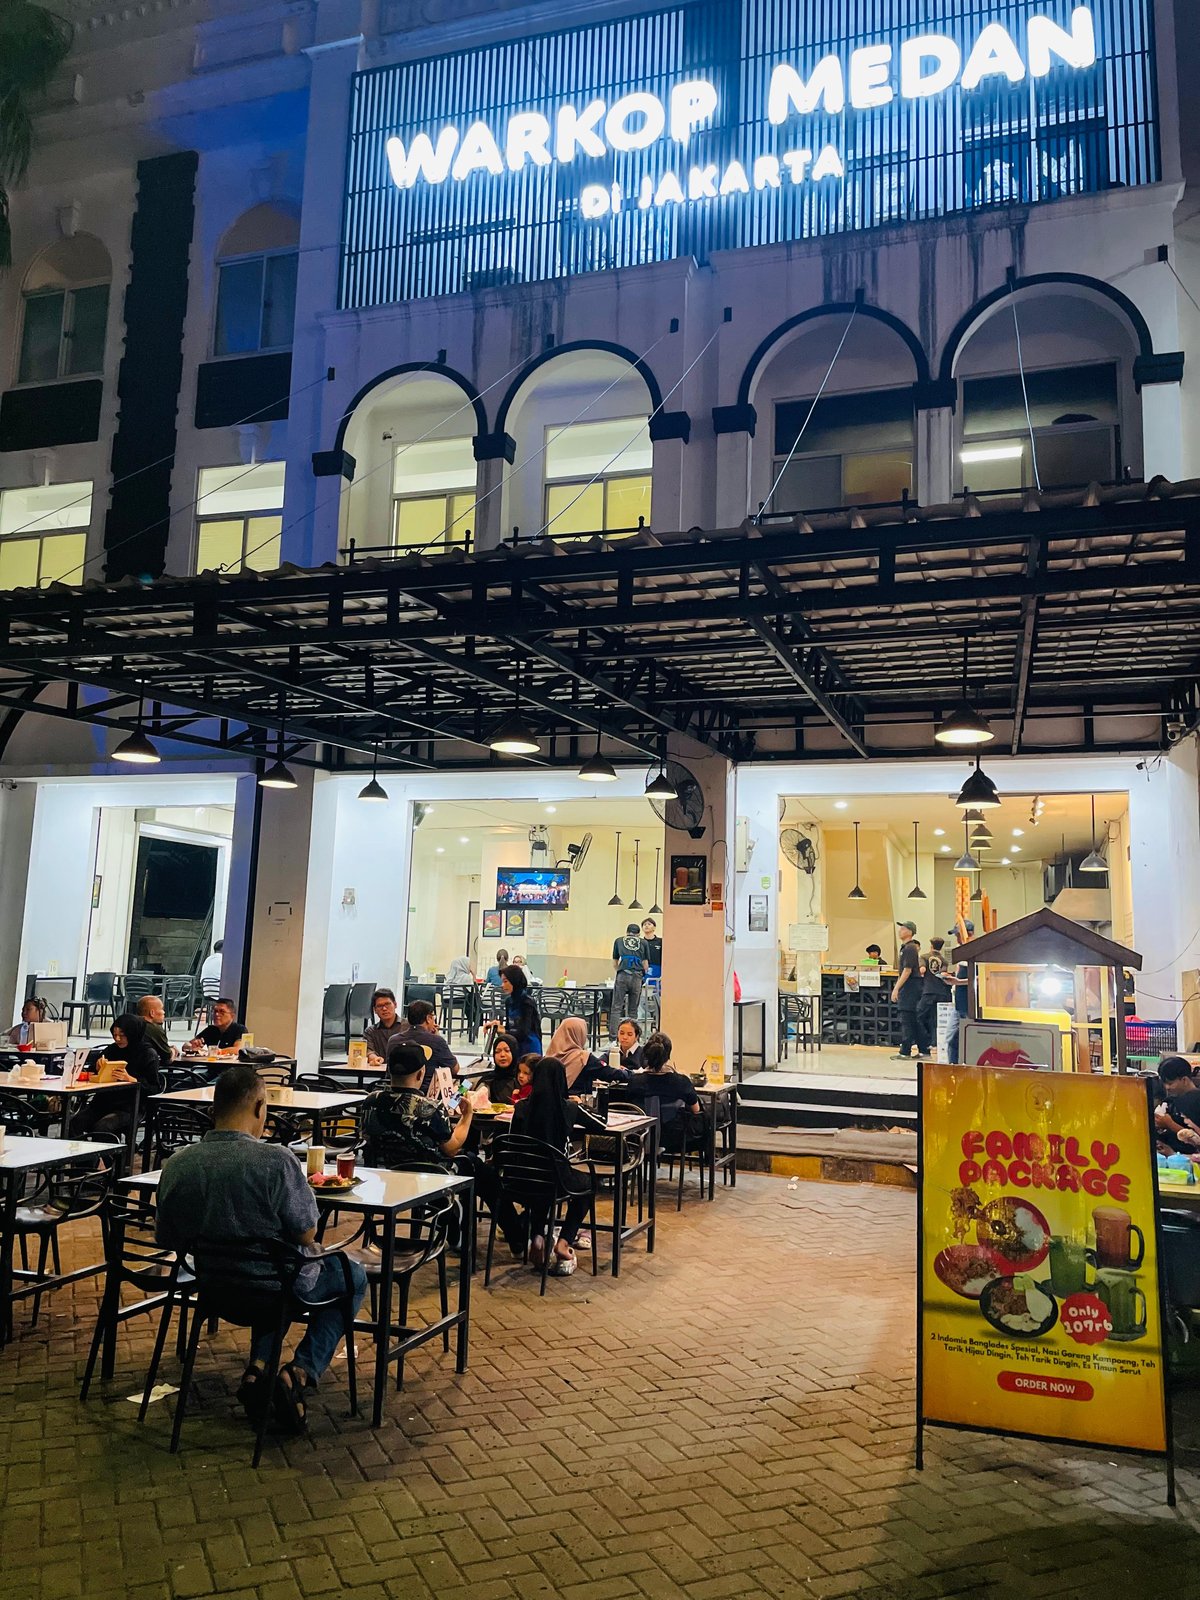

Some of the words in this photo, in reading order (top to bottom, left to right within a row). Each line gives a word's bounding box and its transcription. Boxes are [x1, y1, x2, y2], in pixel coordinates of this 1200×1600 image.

[386, 80, 718, 189] WARKOP
[768, 6, 1096, 125] MEDAN
[638, 144, 844, 210] JAKARTA
[961, 1130, 1120, 1171] FAMILY
[959, 1159, 1131, 1202] PACKAGE
[1063, 1319, 1113, 1334] 107rb
[1068, 1305, 1099, 1318] Only
[930, 1332, 936, 1340] 2
[937, 1334, 968, 1344] Indomie
[969, 1338, 1009, 1349] Banglades
[1010, 1344, 1041, 1355] Spesial,
[1042, 1348, 1060, 1356] Nasi
[1061, 1350, 1091, 1361] Goreng
[1141, 1360, 1156, 1368] Teh
[944, 1343, 963, 1353] Tarik
[965, 1347, 985, 1356] Hijau
[986, 1349, 1014, 1360] Dingin,
[1015, 1353, 1030, 1361] Teh
[1031, 1354, 1051, 1364] Tarik
[1053, 1358, 1081, 1369] Dingin,
[1093, 1363, 1118, 1373] Timun
[1119, 1366, 1142, 1376] Serut
[1014, 1377, 1048, 1391] ORDER
[1049, 1382, 1076, 1394] NOW
